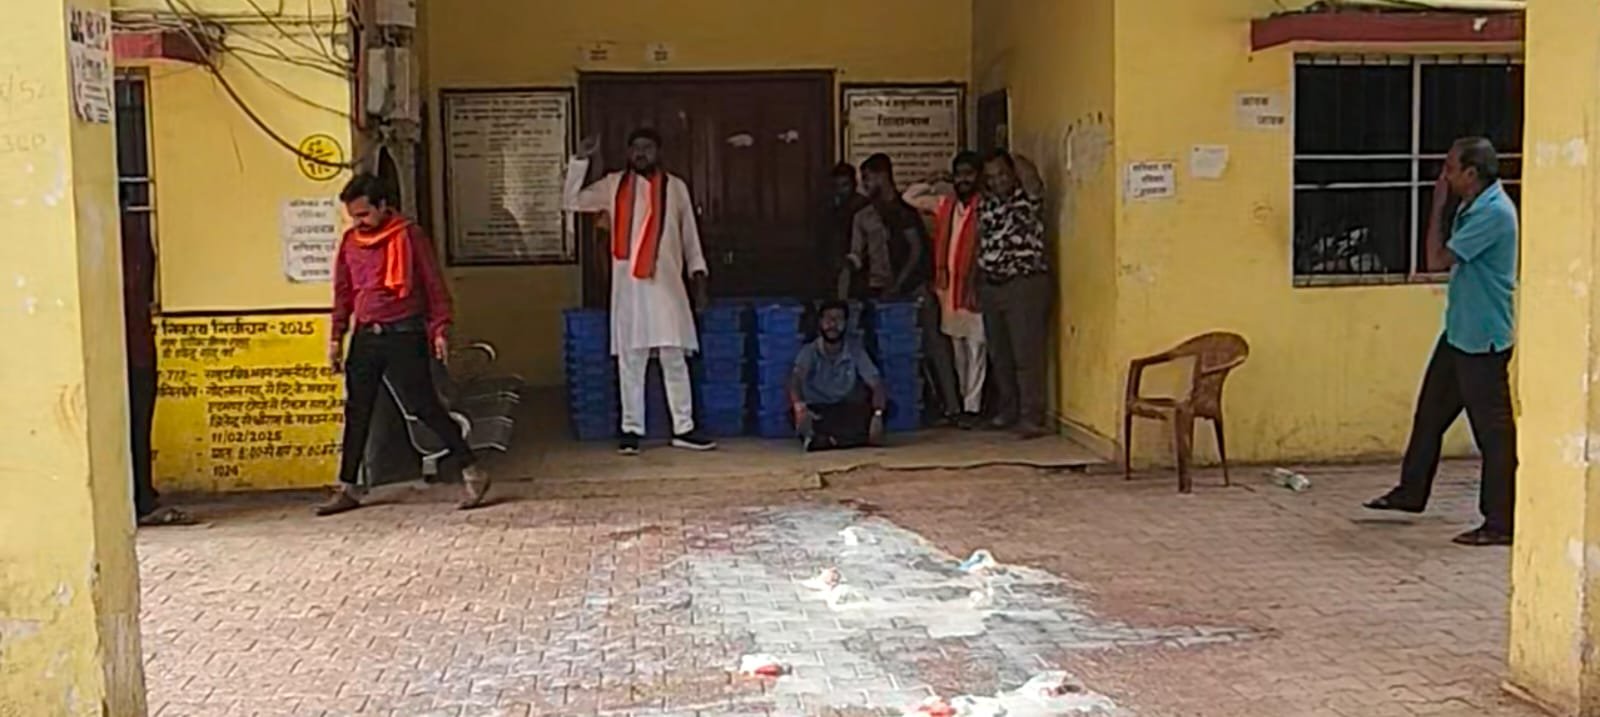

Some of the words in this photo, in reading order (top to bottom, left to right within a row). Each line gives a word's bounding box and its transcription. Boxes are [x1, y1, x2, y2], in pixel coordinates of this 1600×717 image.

[161, 319, 209, 335] निकाय
[211, 316, 268, 335] निर्वाचन
[279, 320, 315, 336] 2025
[211, 429, 283, 444] 11/02/2025
[213, 465, 239, 477] 1024
